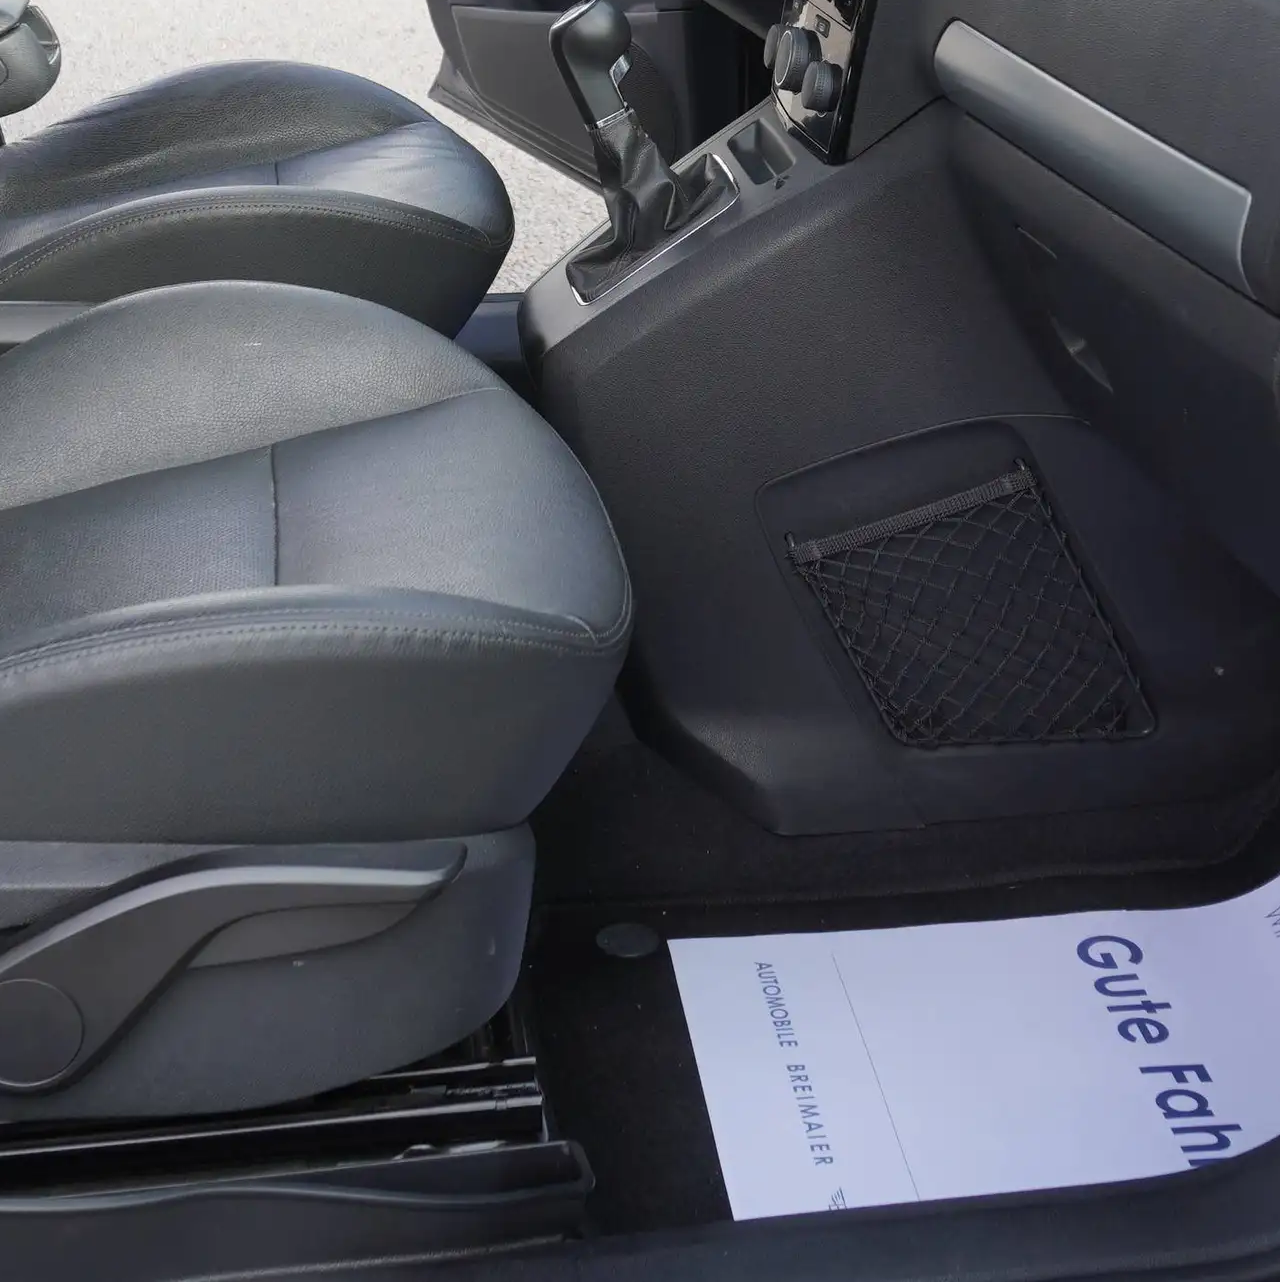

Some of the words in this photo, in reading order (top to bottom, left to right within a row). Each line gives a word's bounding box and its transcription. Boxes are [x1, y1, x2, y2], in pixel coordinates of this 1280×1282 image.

[754, 961, 799, 1048] AUTOMOBILE
[786, 1064, 834, 1166] BREIMAIER
[1076, 935, 1172, 1044] Gute
